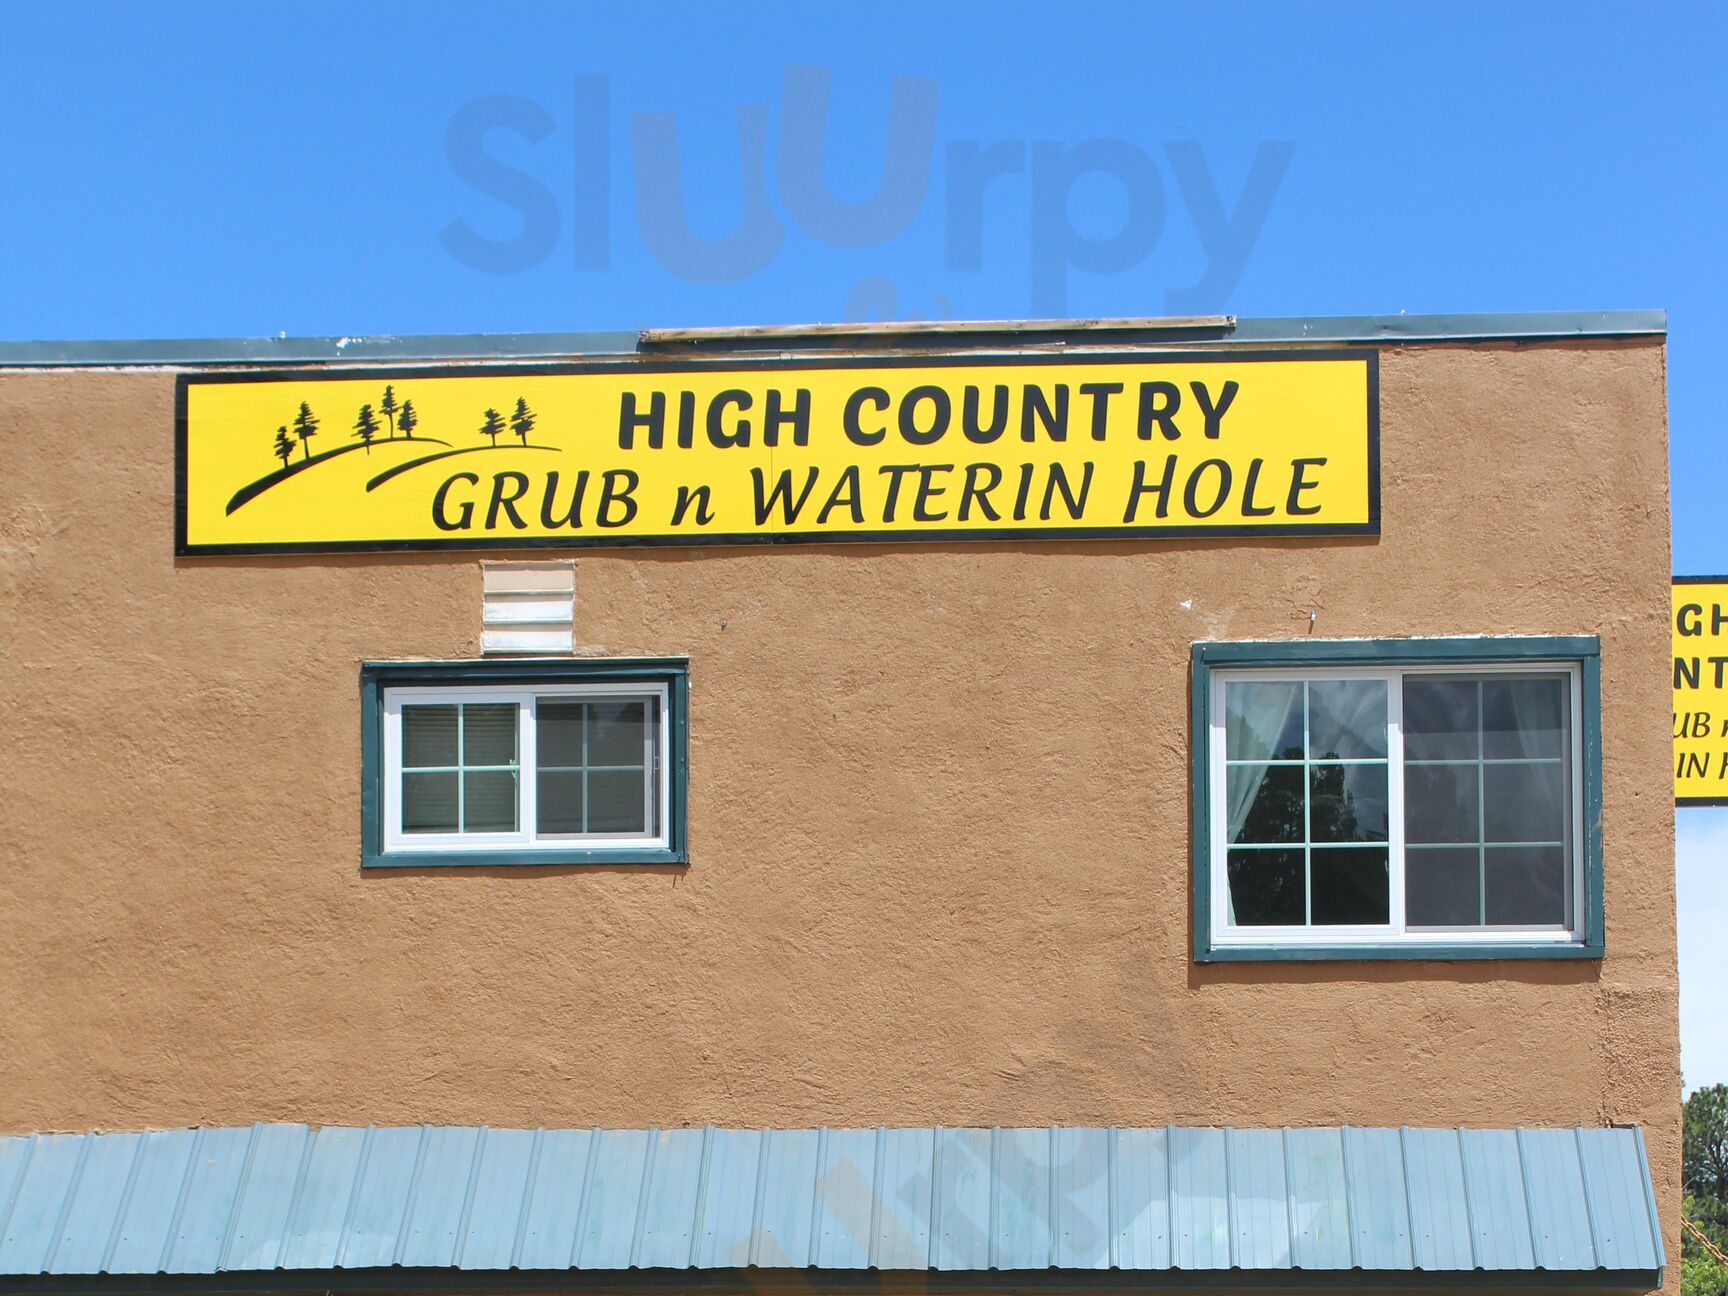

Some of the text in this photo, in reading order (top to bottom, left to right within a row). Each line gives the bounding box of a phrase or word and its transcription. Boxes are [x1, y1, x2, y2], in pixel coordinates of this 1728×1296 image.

[619, 381, 1239, 449] HIGH COUNTRY
[432, 455, 1327, 530] GRUB n WATERIN HOLE
